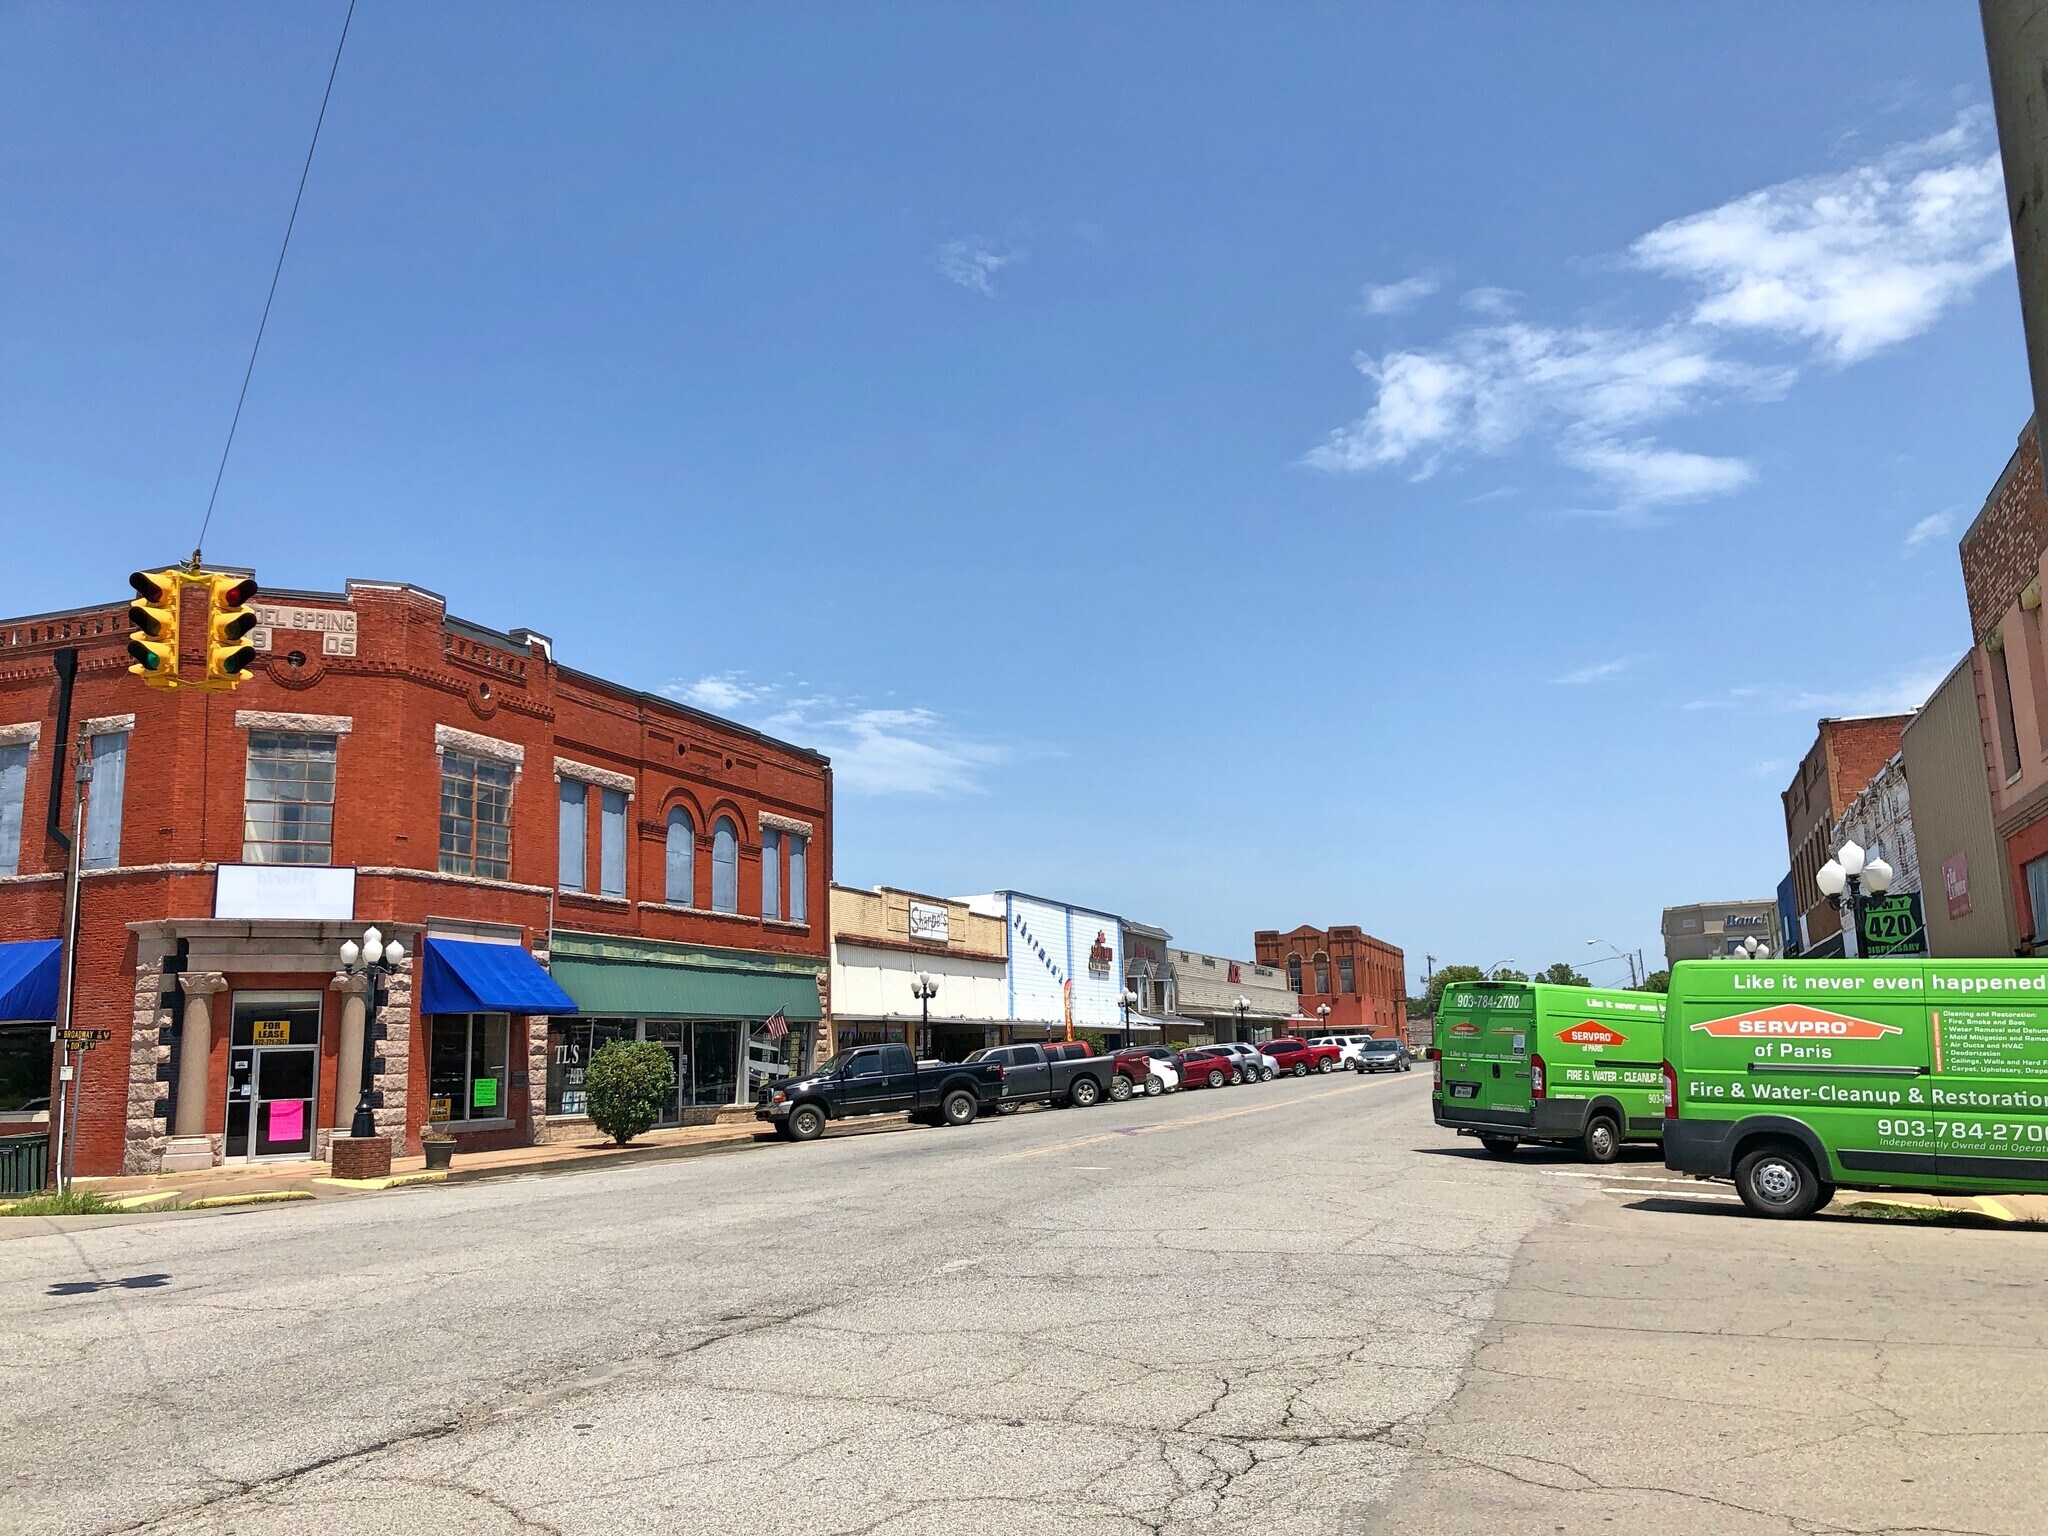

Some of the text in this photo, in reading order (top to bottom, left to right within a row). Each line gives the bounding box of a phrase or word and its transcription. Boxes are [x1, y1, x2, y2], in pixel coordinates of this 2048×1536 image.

[293, 610, 354, 632] SPRING
[325, 636, 355, 654] 05
[1869, 914, 1912, 938] 420
[1734, 973, 2046, 993] Like it never even happened
[1457, 994, 1520, 1009] 903-784-2700
[1586, 998, 1604, 1008] Like
[1605, 1000, 1613, 1008] it
[1615, 1001, 1637, 1010] never
[1639, 1003, 1658, 1012] even
[1943, 1010, 1974, 1019] Cleaning
[263, 1022, 281, 1030] FOR
[1738, 1020, 1847, 1034] SERVPRO
[64, 1030, 94, 1039] BROADWAY
[258, 1030, 285, 1038] LEASE
[1571, 1031, 1611, 1042] SERVPRO
[1969, 1034, 2007, 1042] Mitigation
[554, 1044, 580, 1065] TL'S
[1582, 1044, 1604, 1053] of PARIS
[1755, 1042, 1832, 1059] of Paris
[1566, 1069, 1582, 1080] FIRE
[1584, 1070, 1590, 1081] &
[1592, 1070, 1617, 1082] WATER
[1624, 1071, 1657, 1083] CLEANUP
[1689, 1081, 1725, 1097] Fire
[1730, 1082, 1746, 1098] &
[1751, 1083, 1901, 1106] Water-Cleanup
[1908, 1087, 1924, 1104] &
[1880, 1138, 2048, 1154] Independently Owned and Operat
